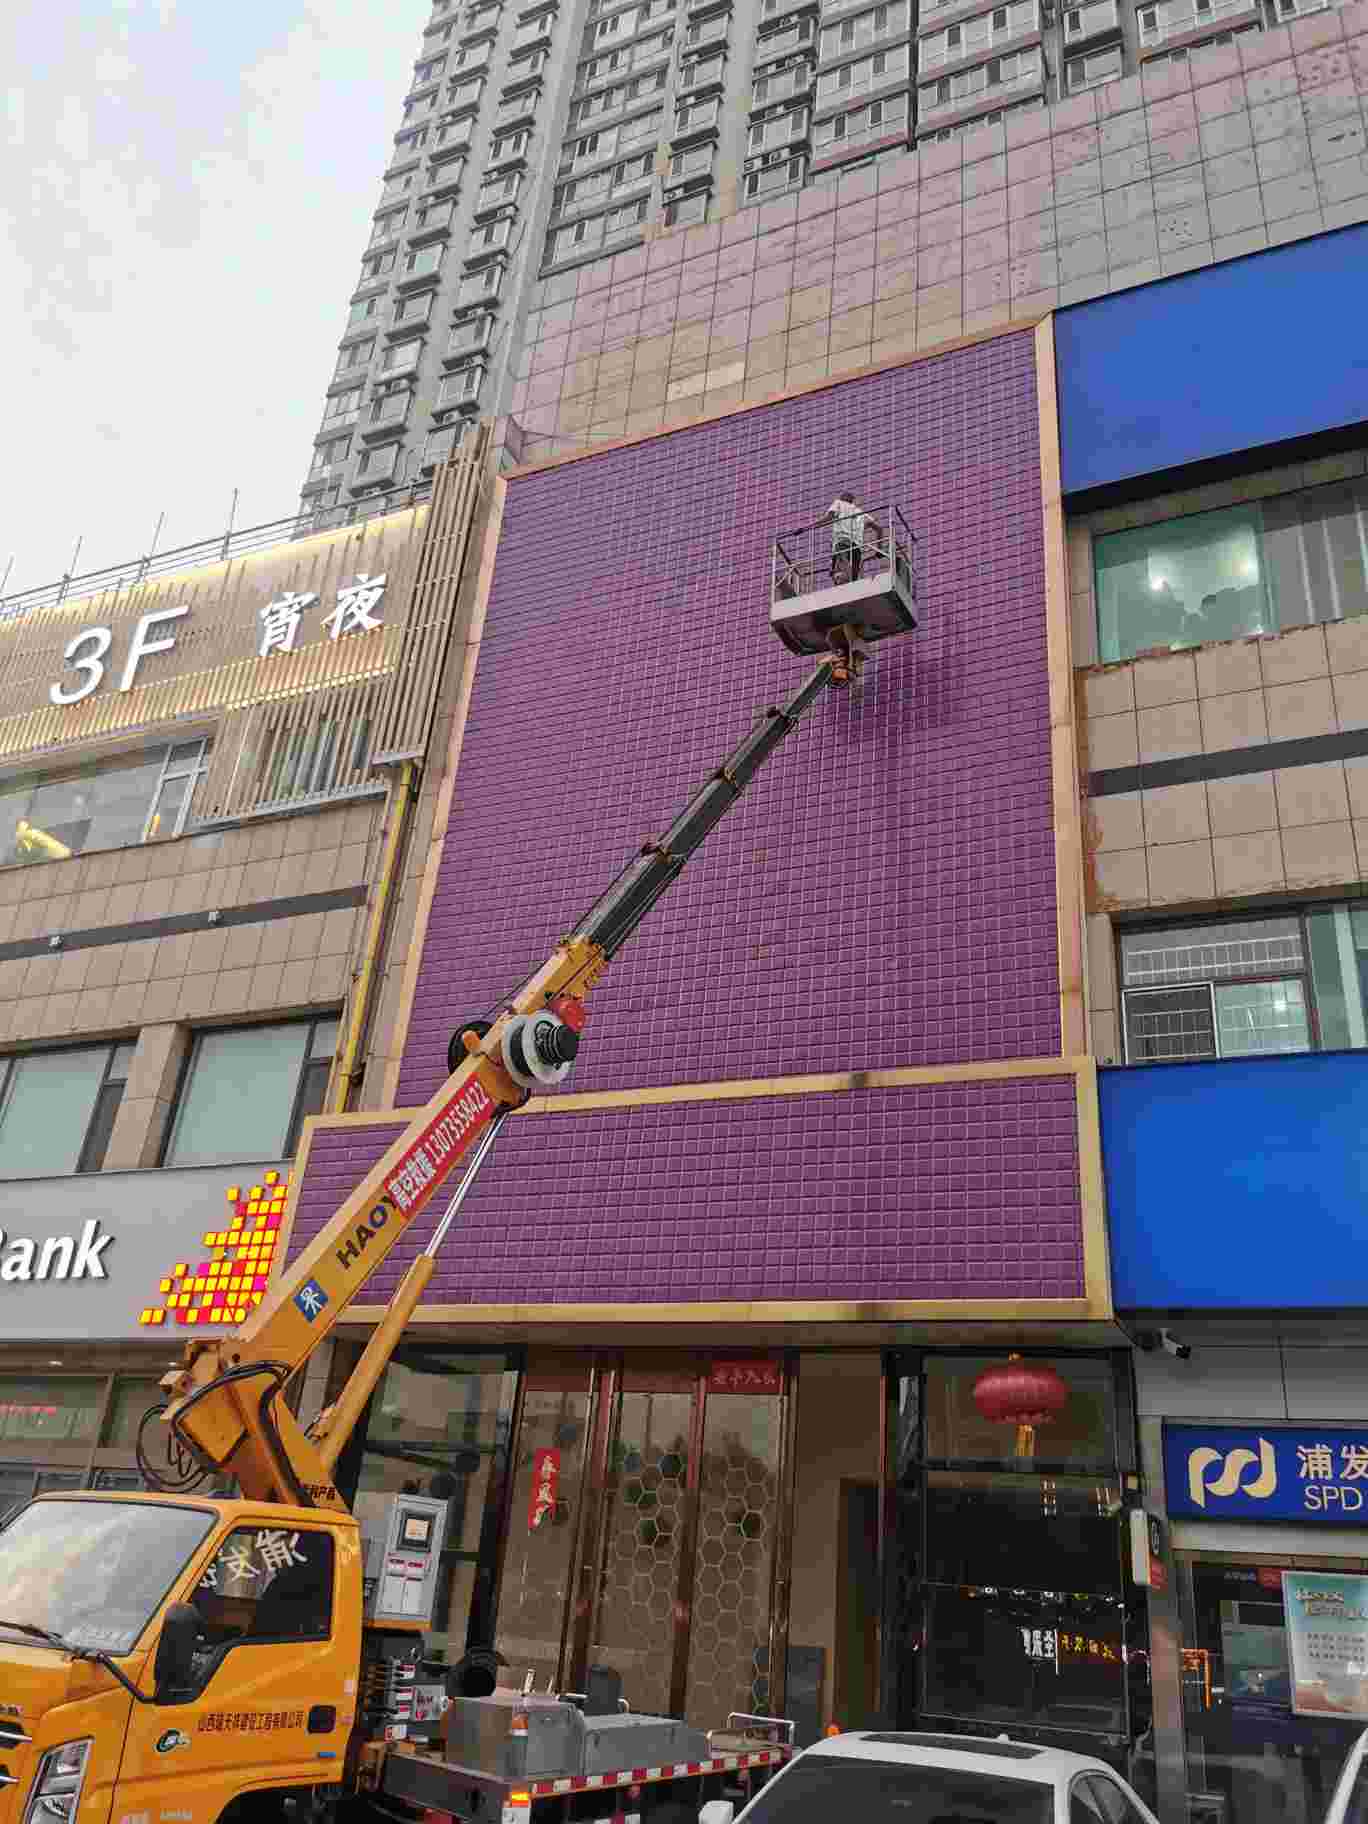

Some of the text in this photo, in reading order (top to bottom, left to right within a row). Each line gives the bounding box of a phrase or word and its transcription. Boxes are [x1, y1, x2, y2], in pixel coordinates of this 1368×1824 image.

[258, 573, 388, 658] 宵夜
[50, 604, 191, 705] 3F
[0, 1219, 112, 1281] ank
[1303, 1484, 1364, 1511] SPD
